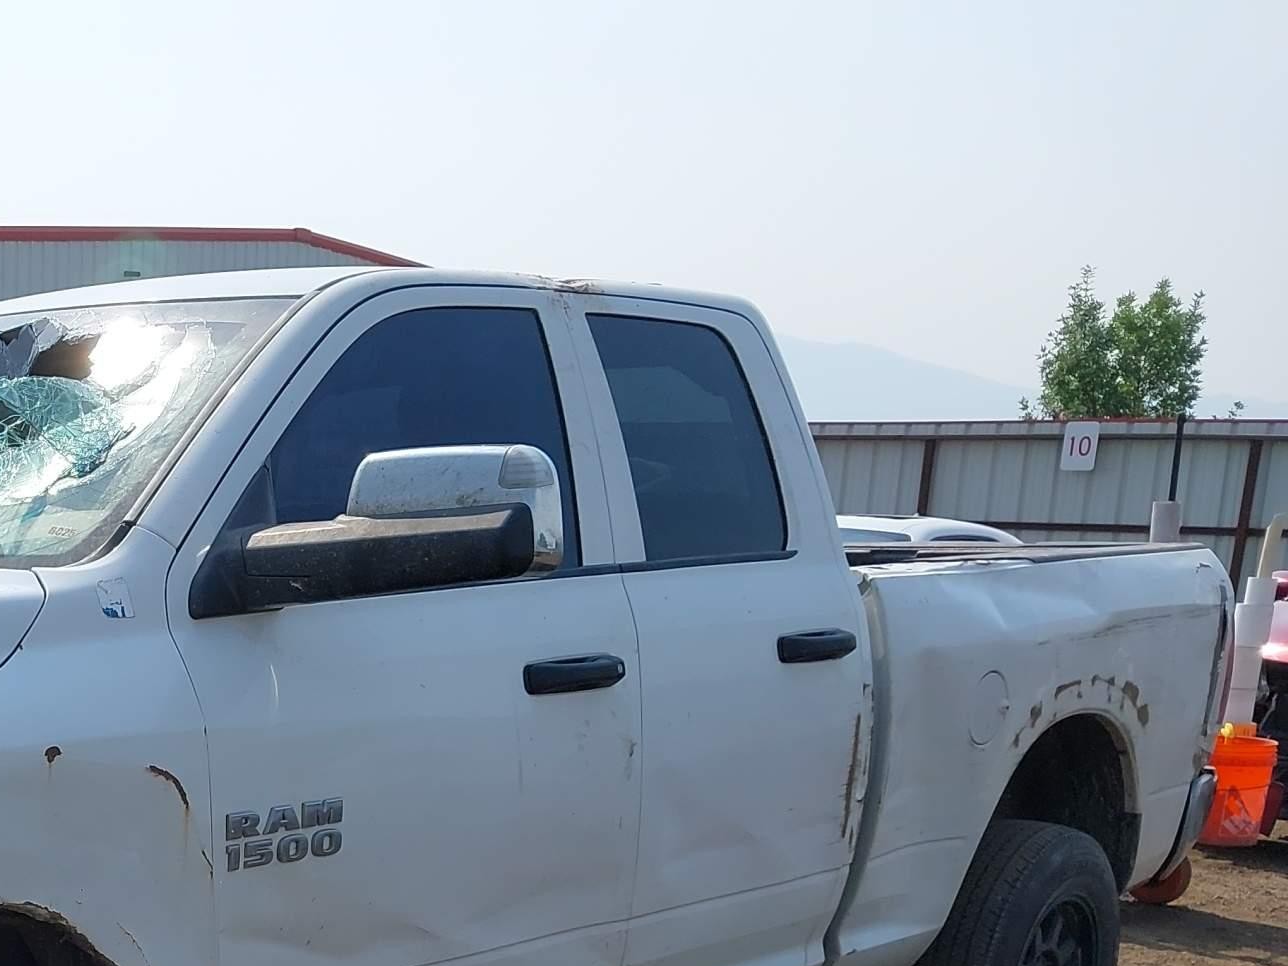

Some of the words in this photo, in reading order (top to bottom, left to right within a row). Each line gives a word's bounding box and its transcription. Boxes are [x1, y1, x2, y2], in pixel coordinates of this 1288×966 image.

[1069, 435, 1092, 457] 10
[225, 797, 344, 841] RAM
[225, 828, 343, 872] 1500
